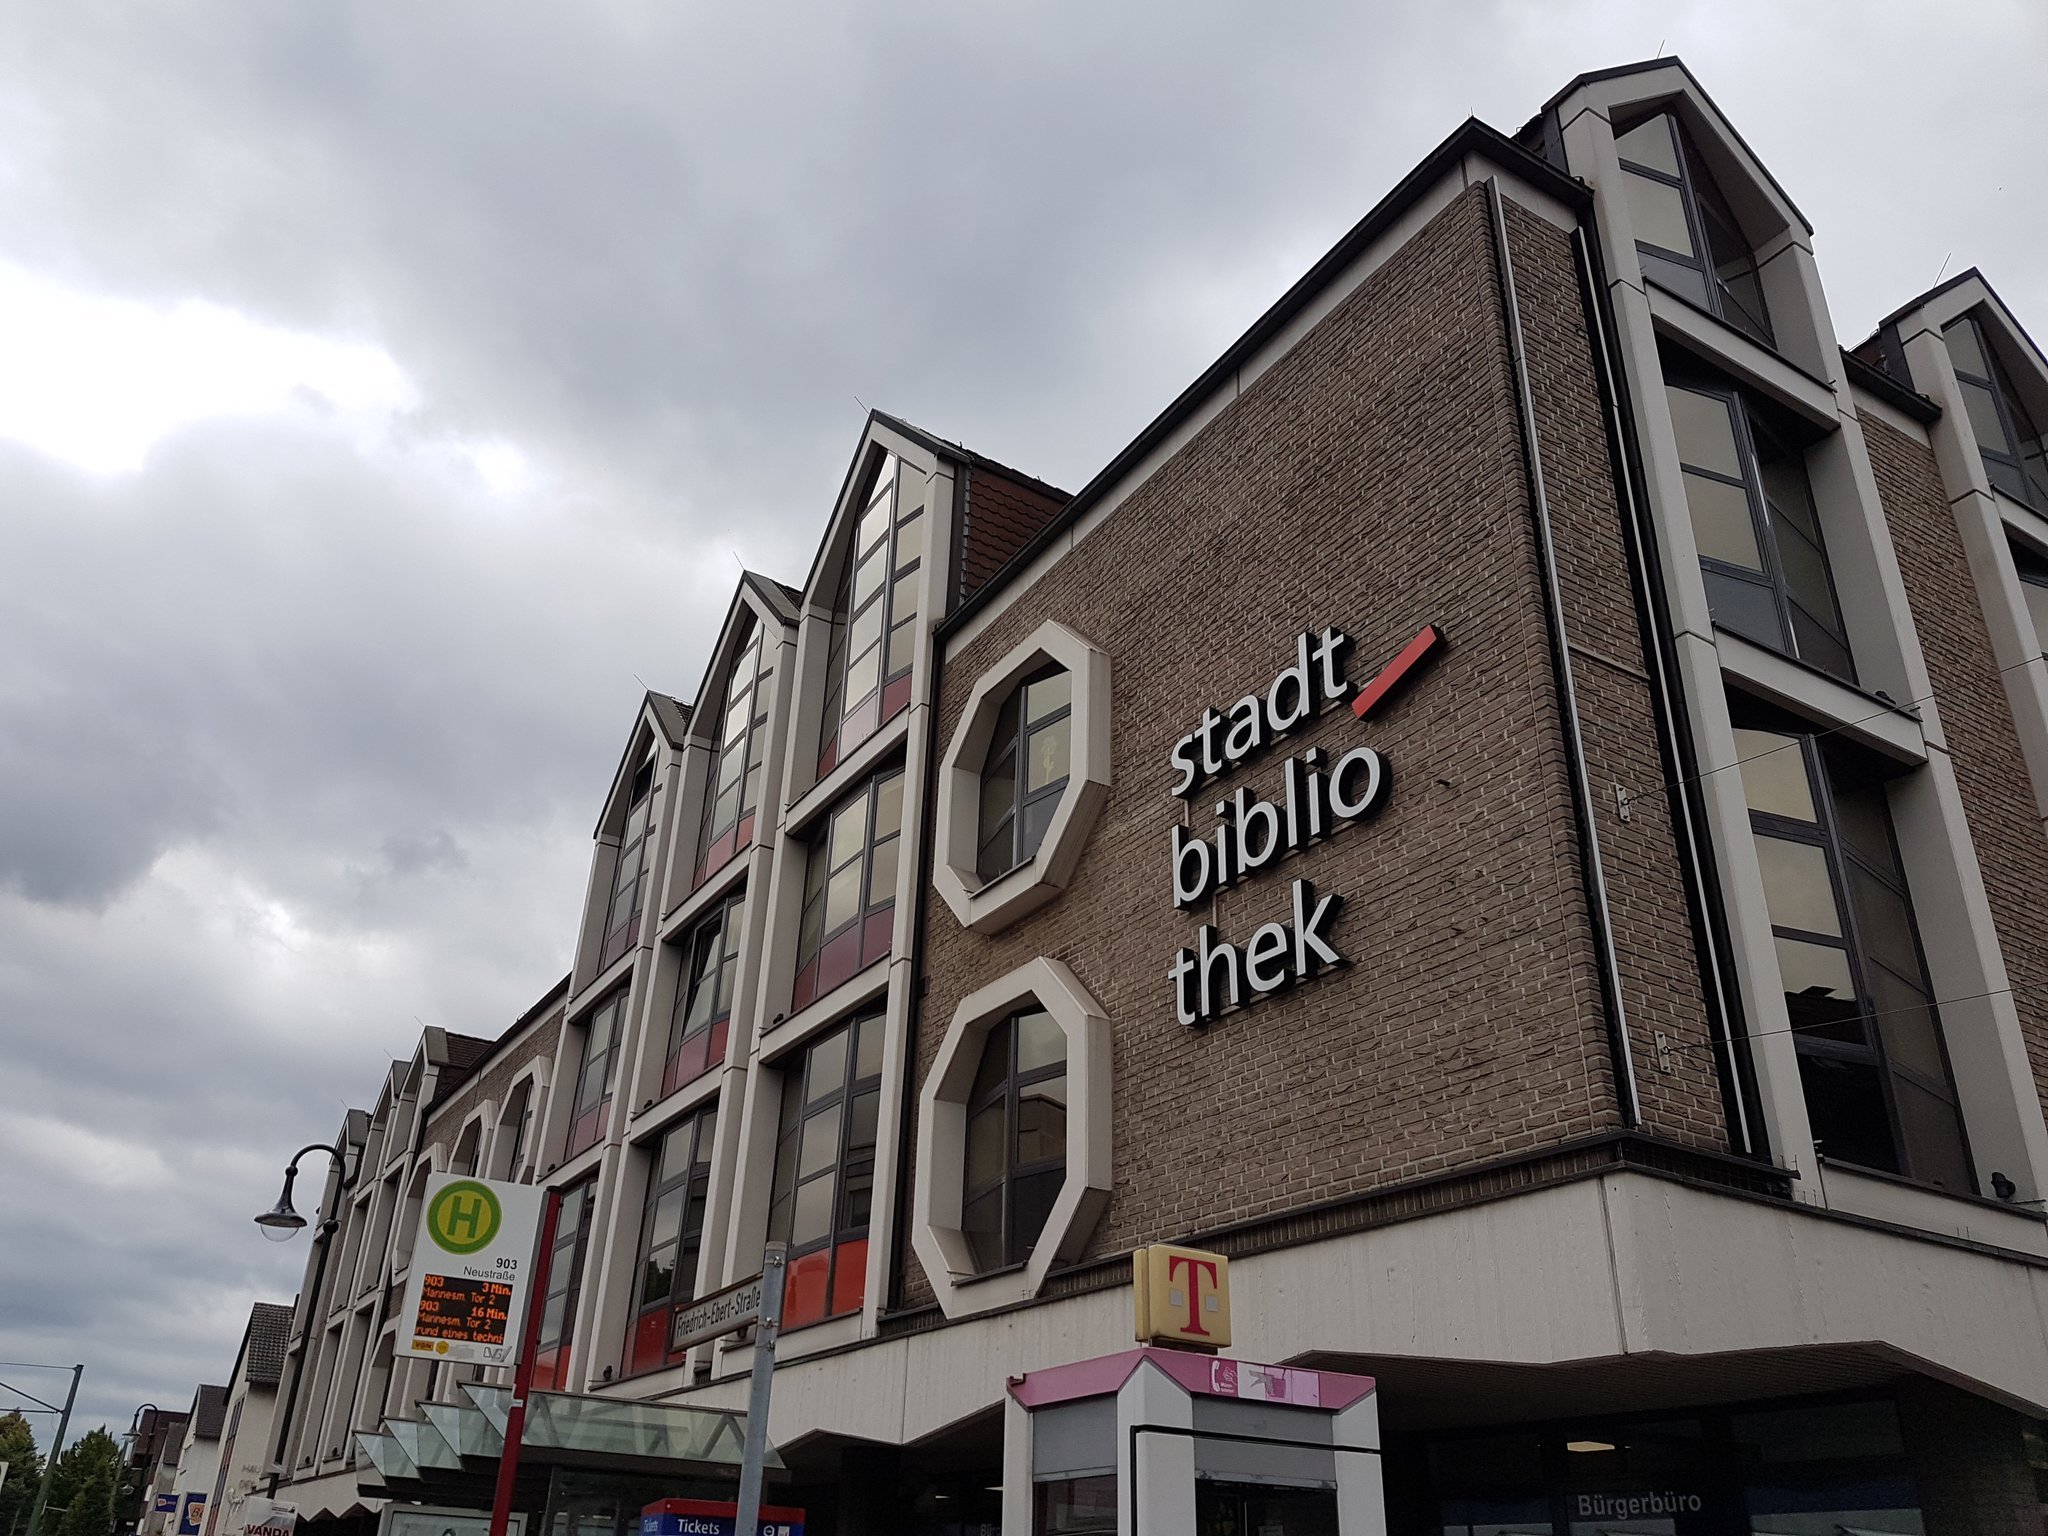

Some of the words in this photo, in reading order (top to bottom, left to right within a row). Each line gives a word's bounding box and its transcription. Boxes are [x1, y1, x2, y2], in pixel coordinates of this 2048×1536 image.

[1171, 626, 1348, 797] stadt
[1171, 747, 1381, 909] biblio
[1168, 879, 1342, 1026] thek
[447, 1195, 482, 1239] H
[463, 1266, 516, 1281] Neustraße
[496, 1258, 517, 1270] 903
[424, 1275, 445, 1287] 903
[482, 1282, 489, 1293] 3
[491, 1283, 512, 1296] Min.
[1169, 1255, 1218, 1337] T
[471, 1291, 486, 1303] Tor
[488, 1294, 496, 1305] 2
[420, 1300, 440, 1311] 903
[471, 1307, 485, 1318] 16
[486, 1307, 507, 1321] Min.
[676, 1286, 761, 1338] Friedrich-Ebert-Straße
[466, 1316, 481, 1328] Tor
[483, 1319, 491, 1330] 2
[441, 1329, 468, 1341] eines
[1577, 1491, 1702, 1520] Bürgerbüro
[677, 1518, 721, 1535] Tickets
